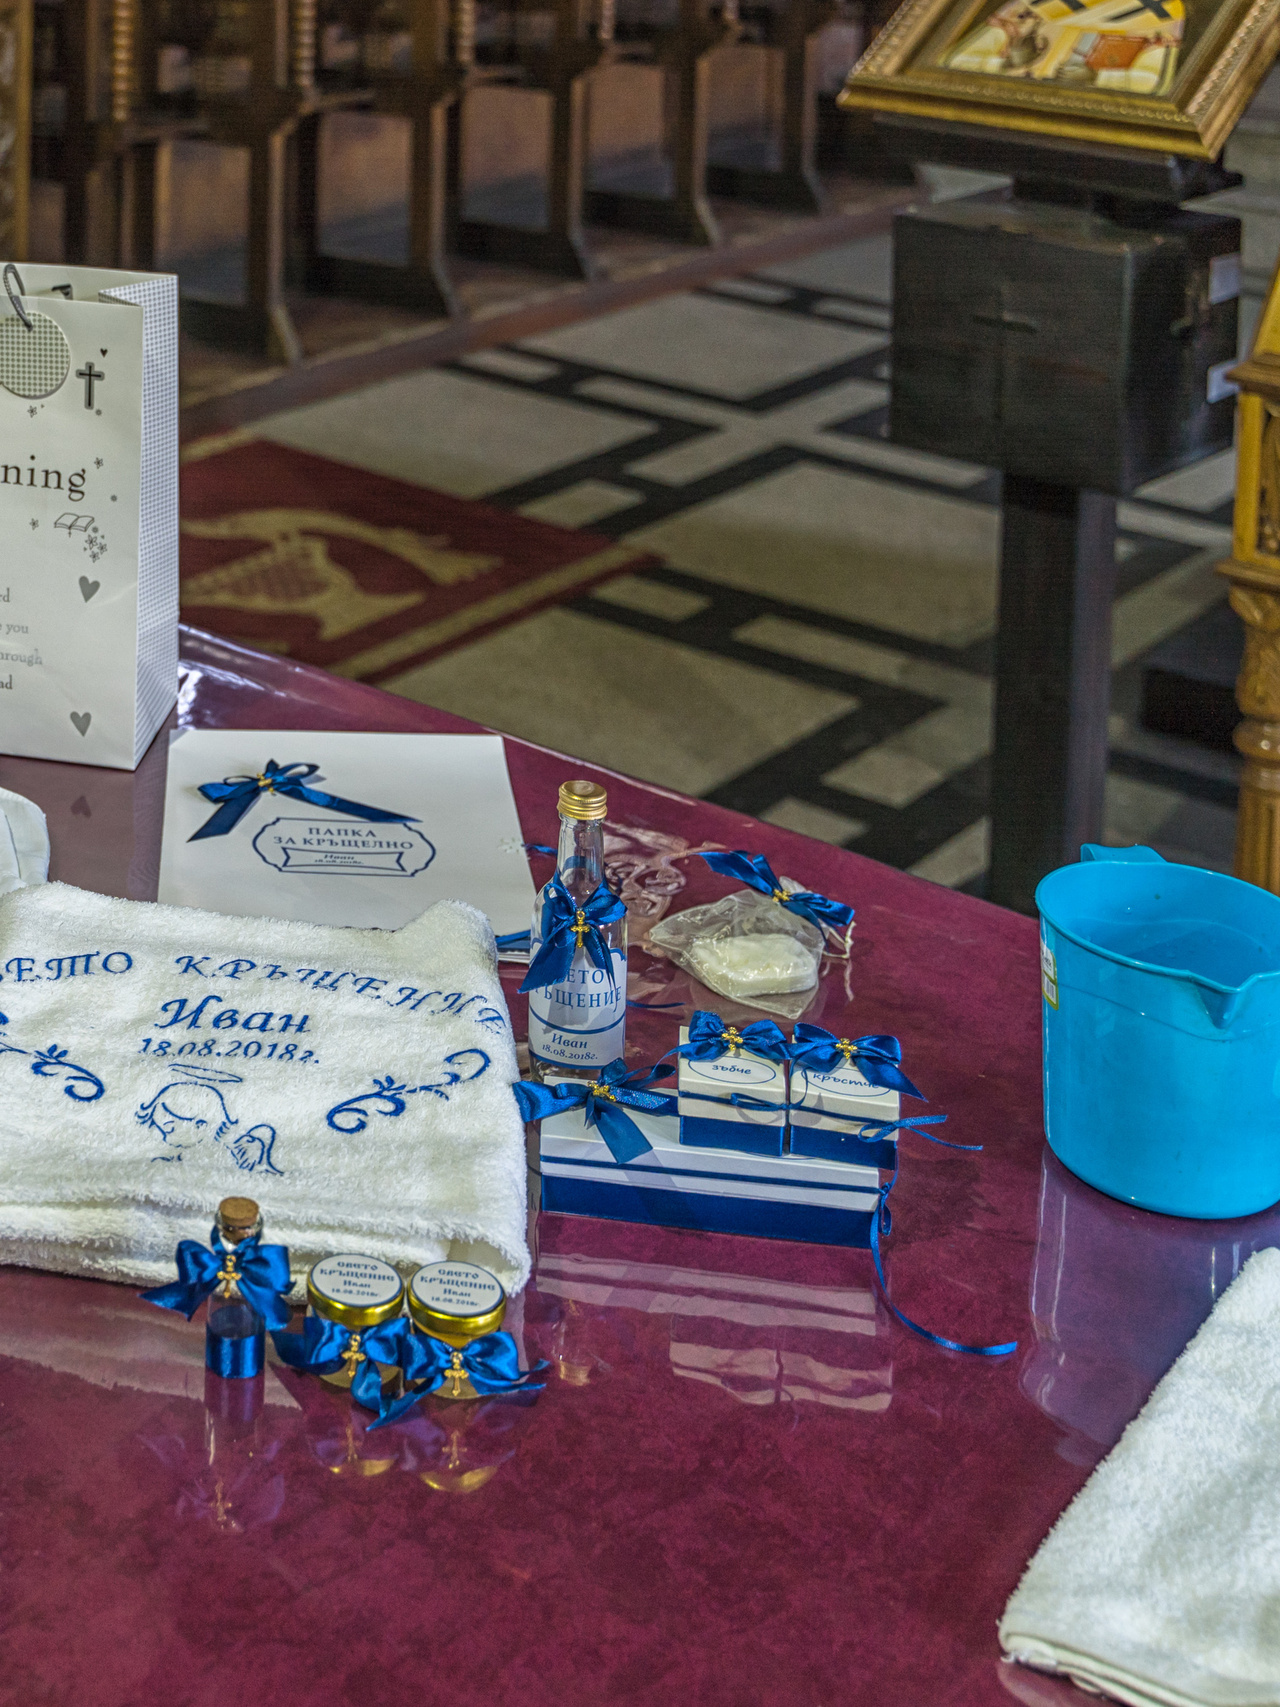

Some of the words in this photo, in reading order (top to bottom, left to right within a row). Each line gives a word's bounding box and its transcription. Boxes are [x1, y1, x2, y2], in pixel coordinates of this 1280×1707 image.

[5, 623, 29, 635] you
[308, 827, 377, 838] ПАПКА
[273, 836, 297, 845] ЗА
[302, 837, 414, 850] КРЪЩЕЛНО
[154, 995, 311, 1034] Иван
[551, 1032, 588, 1049] Иван
[542, 1044, 598, 1060] 18.08.2018г.
[712, 1063, 751, 1075] зъбче
